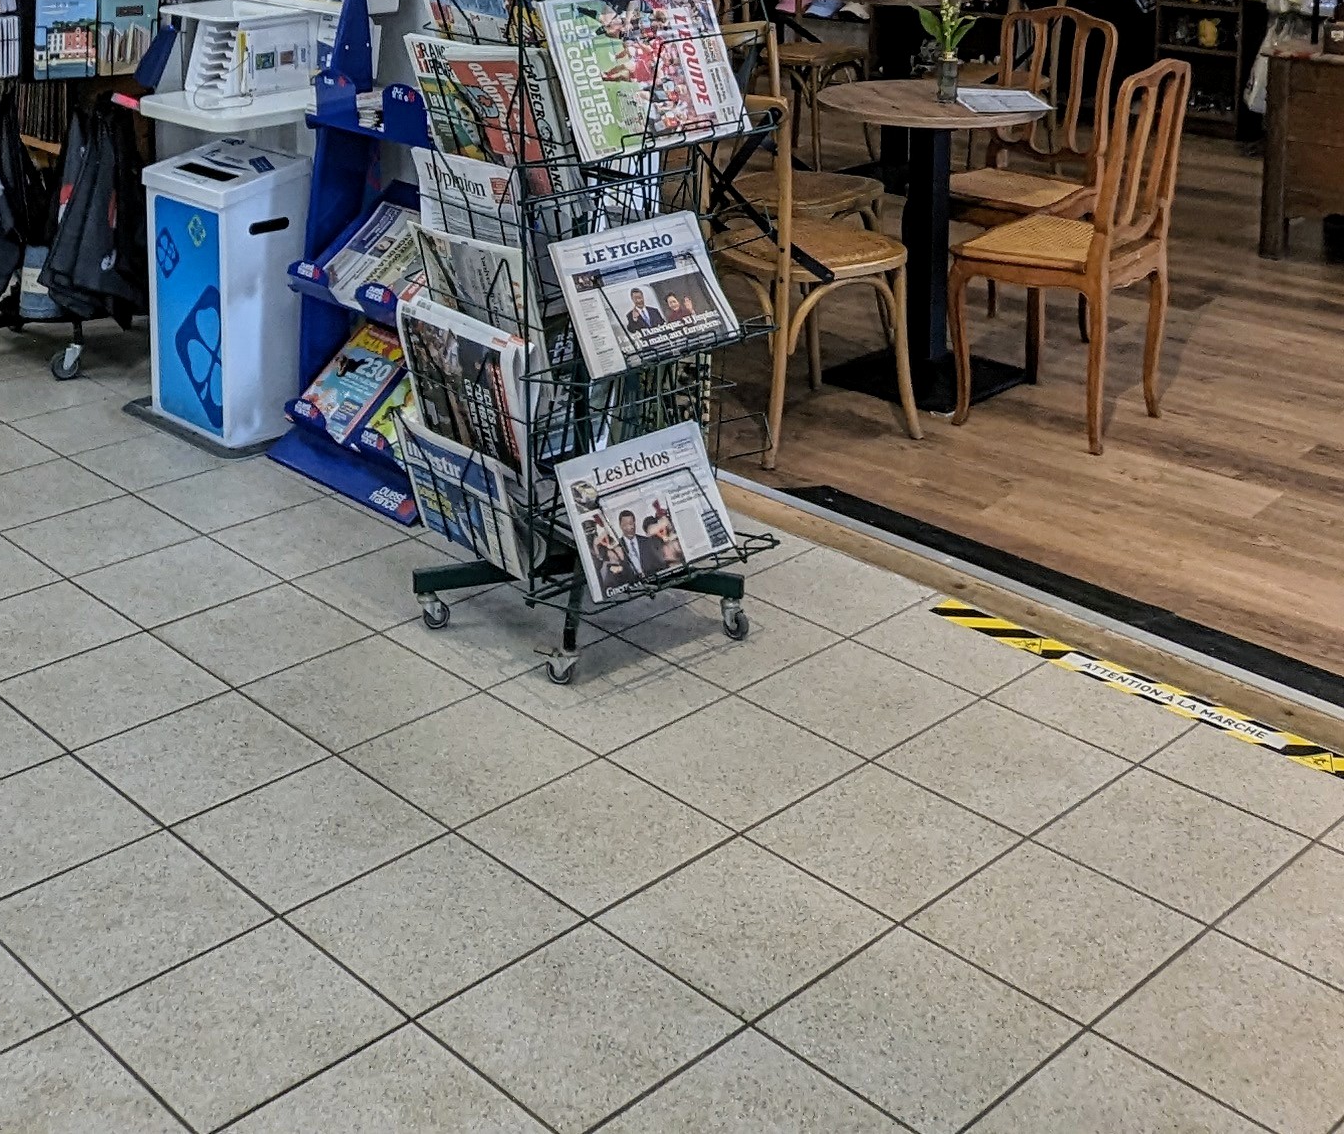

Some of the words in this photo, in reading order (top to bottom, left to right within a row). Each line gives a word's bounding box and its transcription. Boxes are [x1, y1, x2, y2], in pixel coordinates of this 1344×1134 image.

[574, 24, 594, 51] DE
[555, 7, 573, 44] LES
[566, 46, 607, 148] COULEURS
[581, 52, 616, 127] TOUTES
[583, 248, 607, 265] LE
[607, 233, 674, 260] FIGARO
[356, 357, 392, 382] 230
[592, 464, 623, 486] Les
[621, 450, 670, 477] Echos
[369, 489, 399, 512] france
[379, 486, 407, 505] ouest
[1081, 661, 1164, 697] ATTENTION
[1164, 693, 1175, 703] À
[1176, 699, 1196, 712] LA
[1199, 708, 1269, 740] MARCHE
